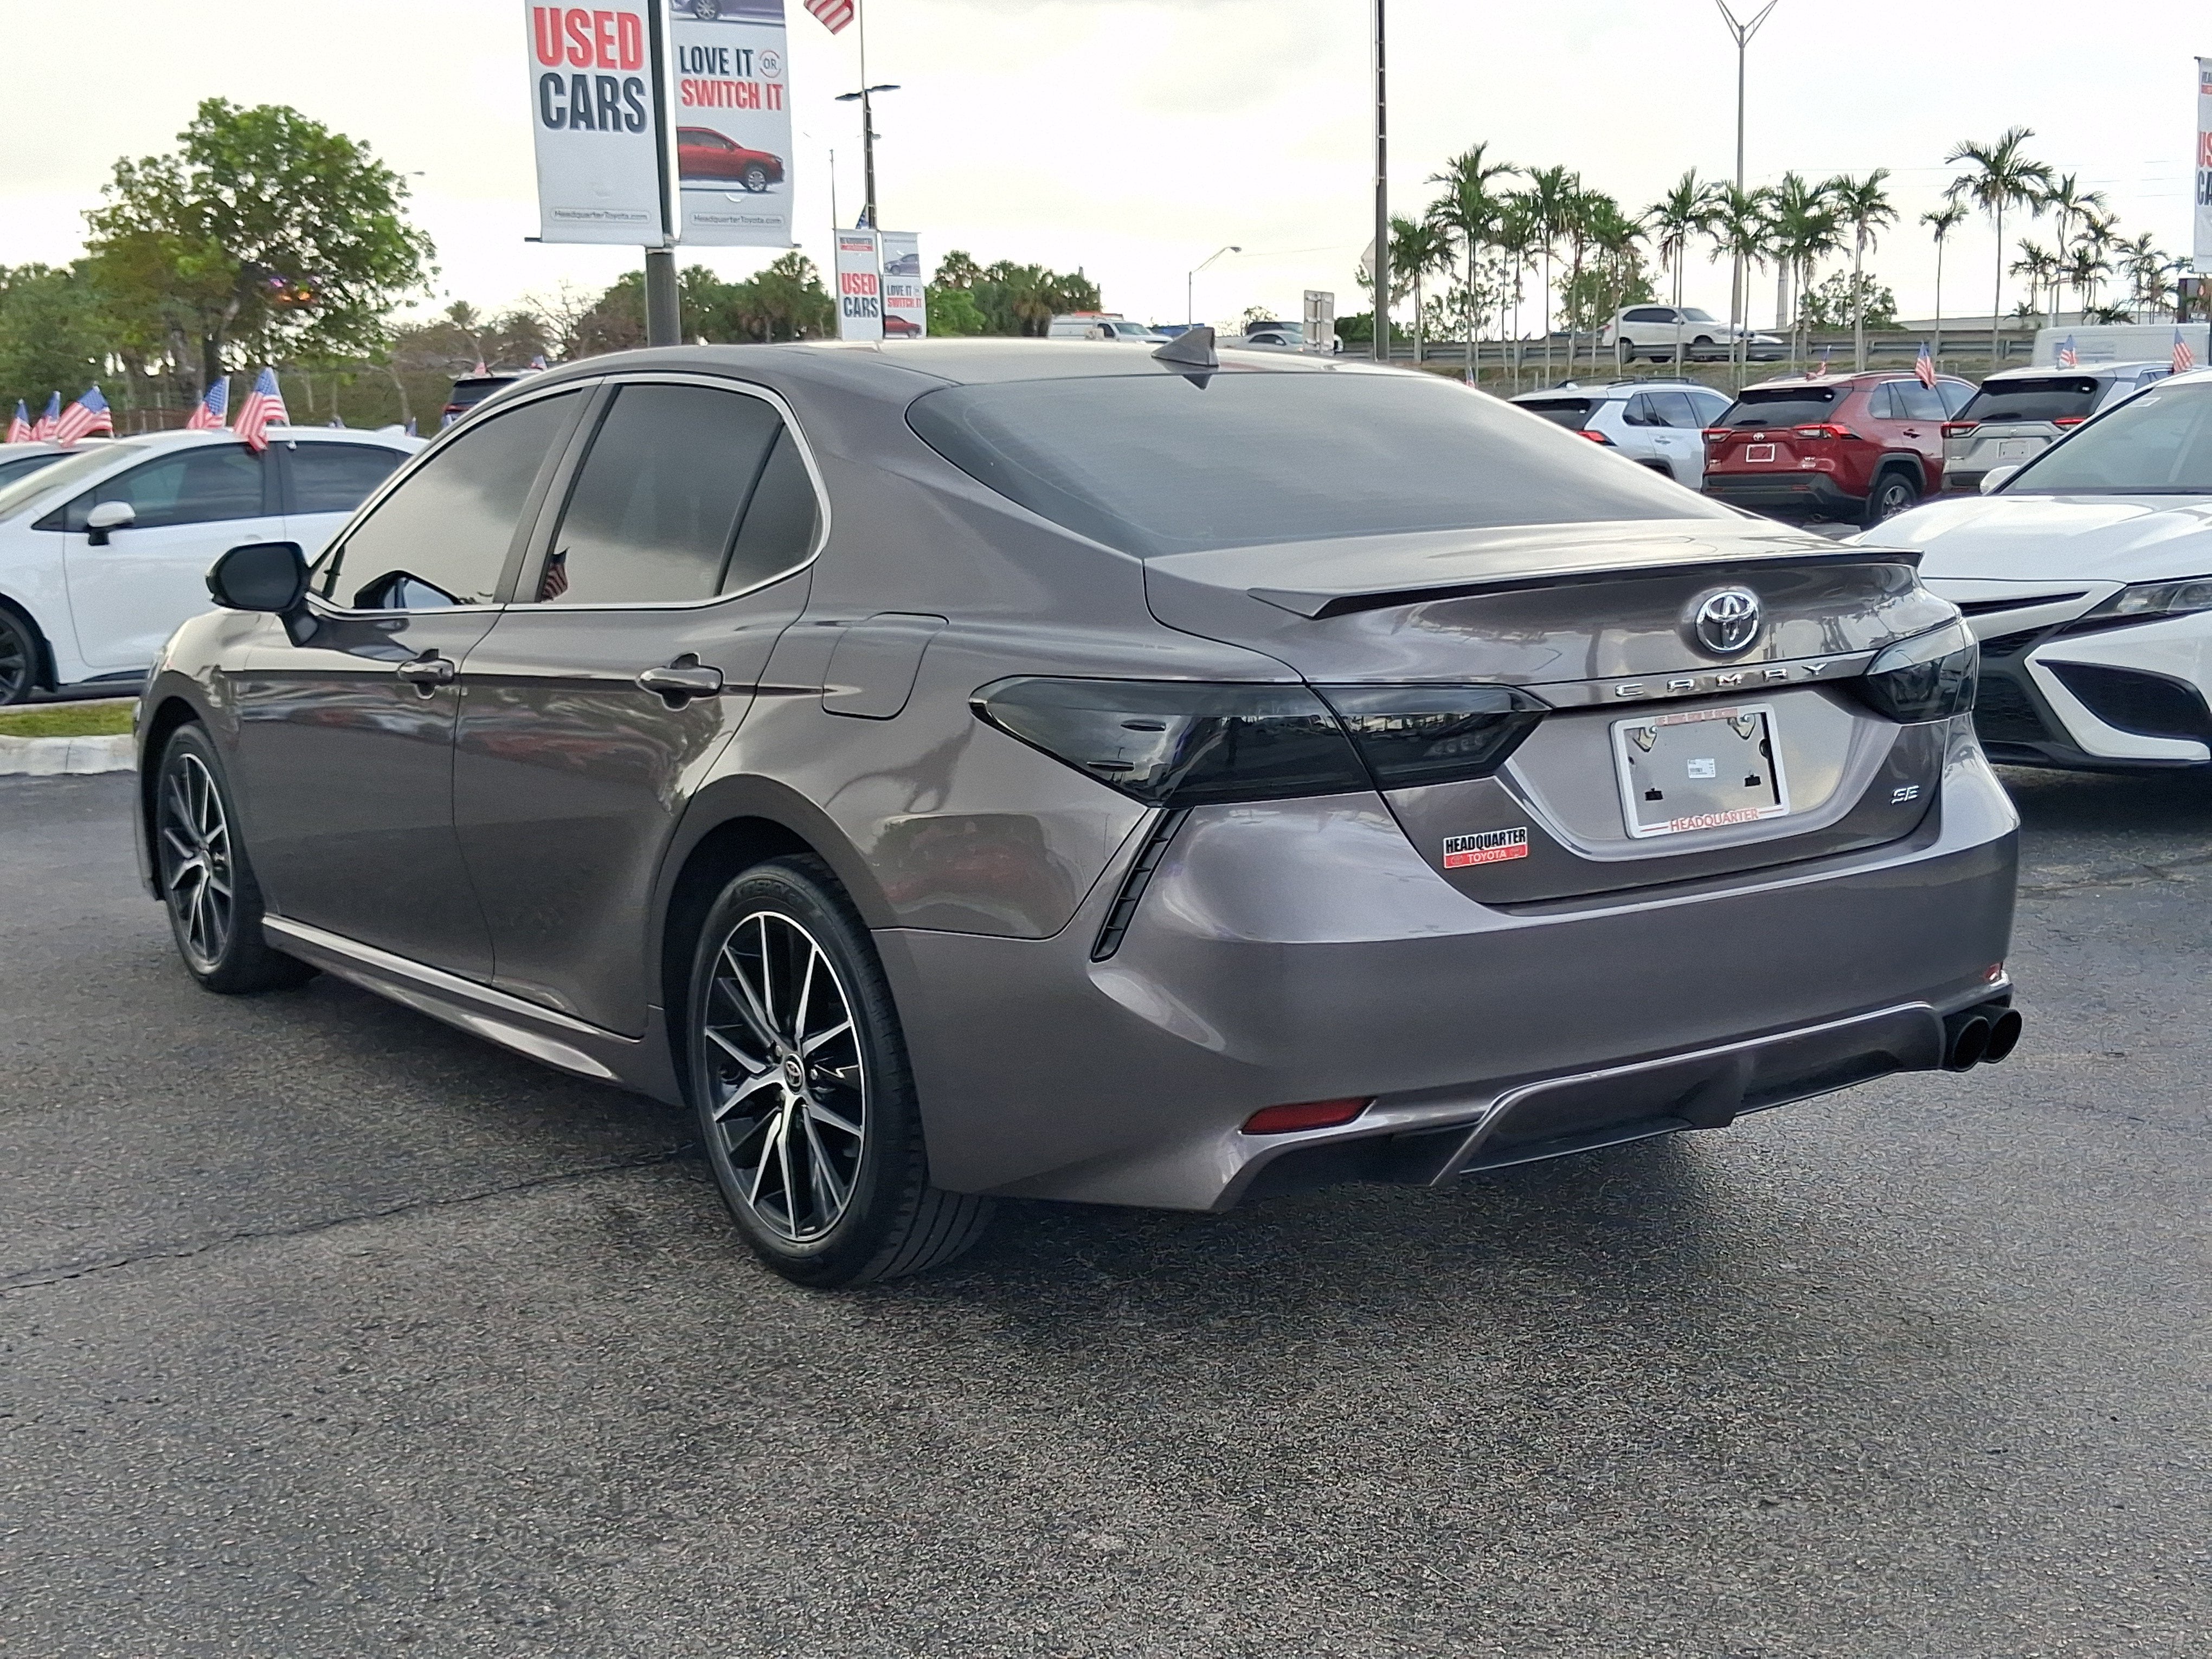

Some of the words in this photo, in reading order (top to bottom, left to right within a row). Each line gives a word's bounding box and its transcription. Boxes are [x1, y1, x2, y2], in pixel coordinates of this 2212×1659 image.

[533, 7, 644, 70] USED
[679, 46, 730, 76] LOVE
[736, 48, 754, 77] IT
[763, 57, 778, 70] OR
[539, 72, 647, 134] CARS
[681, 79, 761, 110] SWITCH
[767, 83, 784, 111] IT
[841, 273, 877, 295] USED
[887, 285, 904, 296] LOVE
[906, 286, 912, 297] IT
[844, 297, 879, 318] CARS
[1616, 663, 1827, 697] CAMRY
[1891, 785, 1920, 805] SE
[1670, 808, 1759, 832] HEADQUARTER
[1445, 828, 1526, 854] HEADQUARTER
[1467, 850, 1507, 864] TOYOTA
